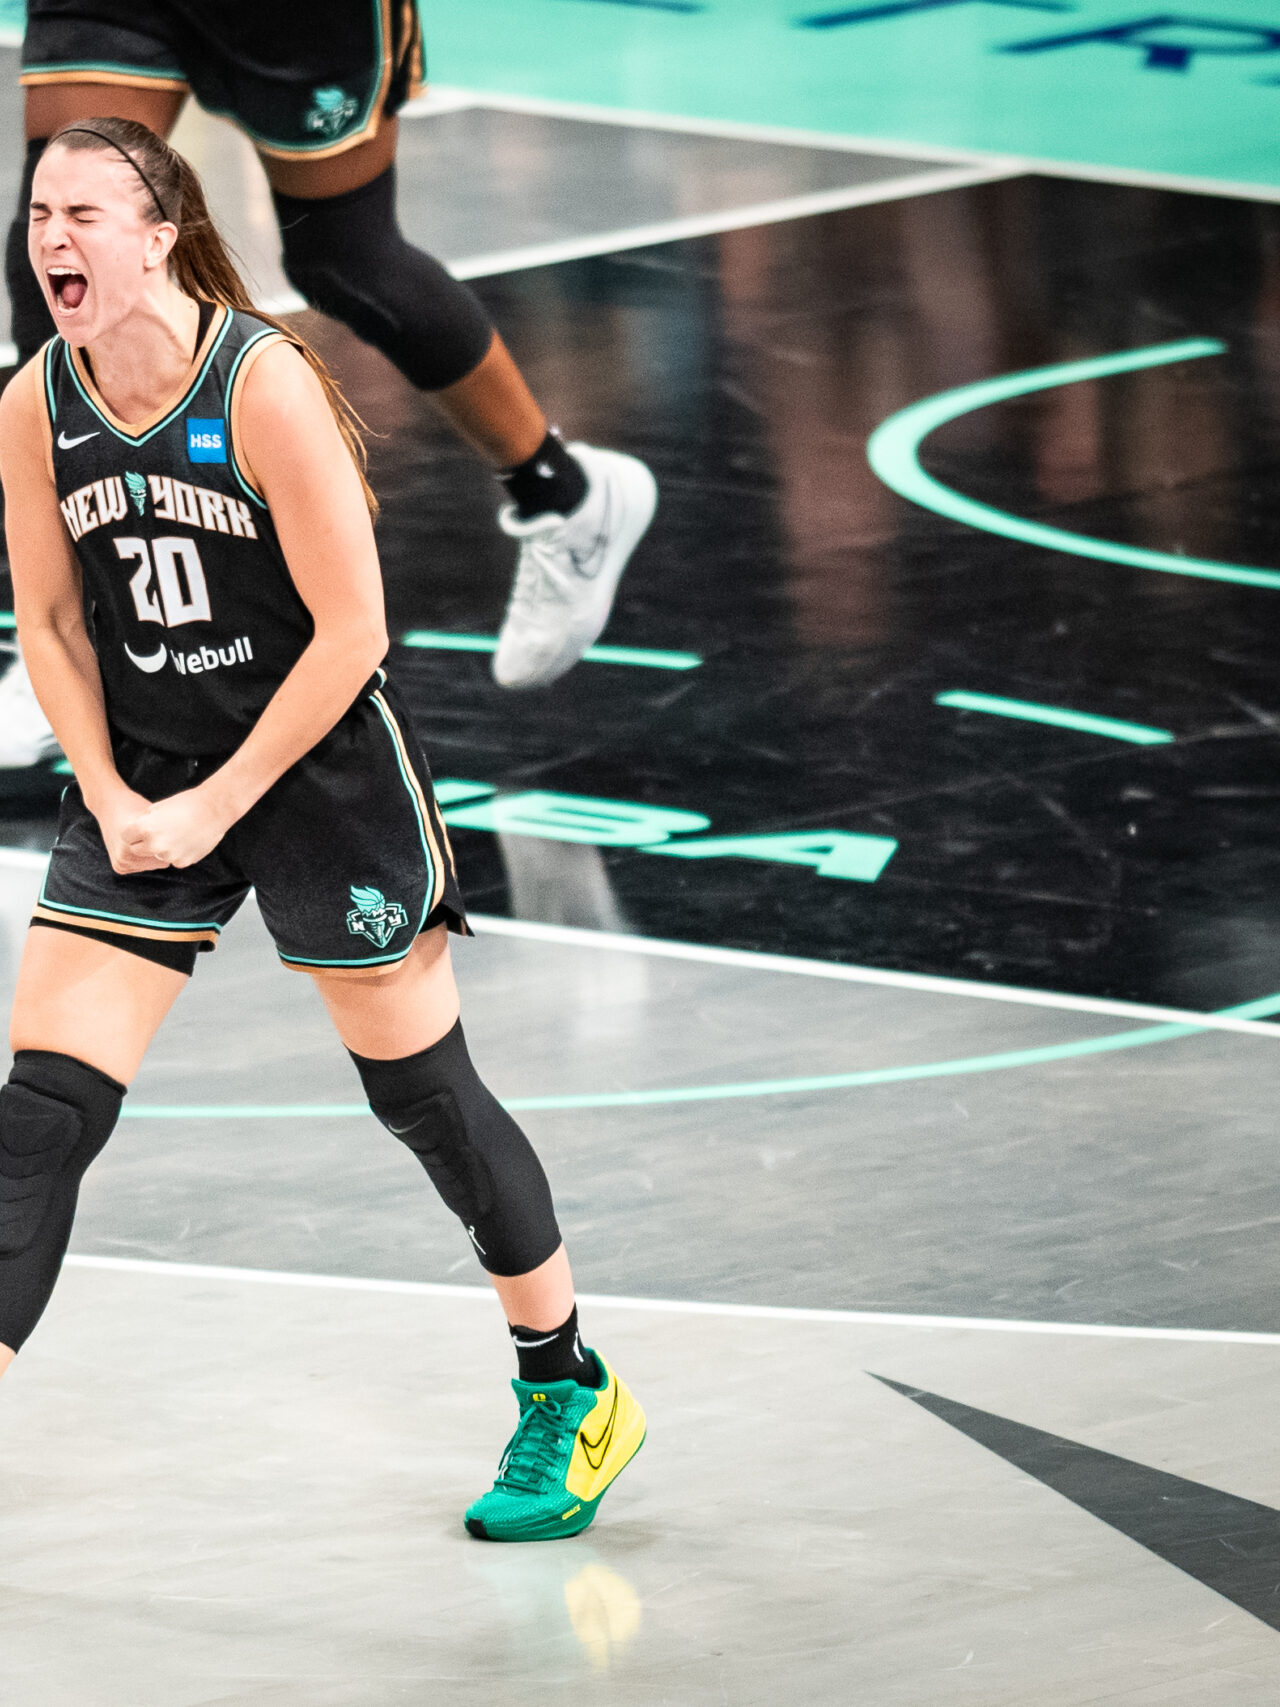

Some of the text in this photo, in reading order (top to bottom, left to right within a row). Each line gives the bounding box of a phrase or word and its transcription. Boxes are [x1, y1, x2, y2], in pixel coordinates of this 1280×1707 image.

[190, 433, 222, 448] HSS
[60, 474, 258, 543] NEW YORK
[113, 536, 212, 628] 20
